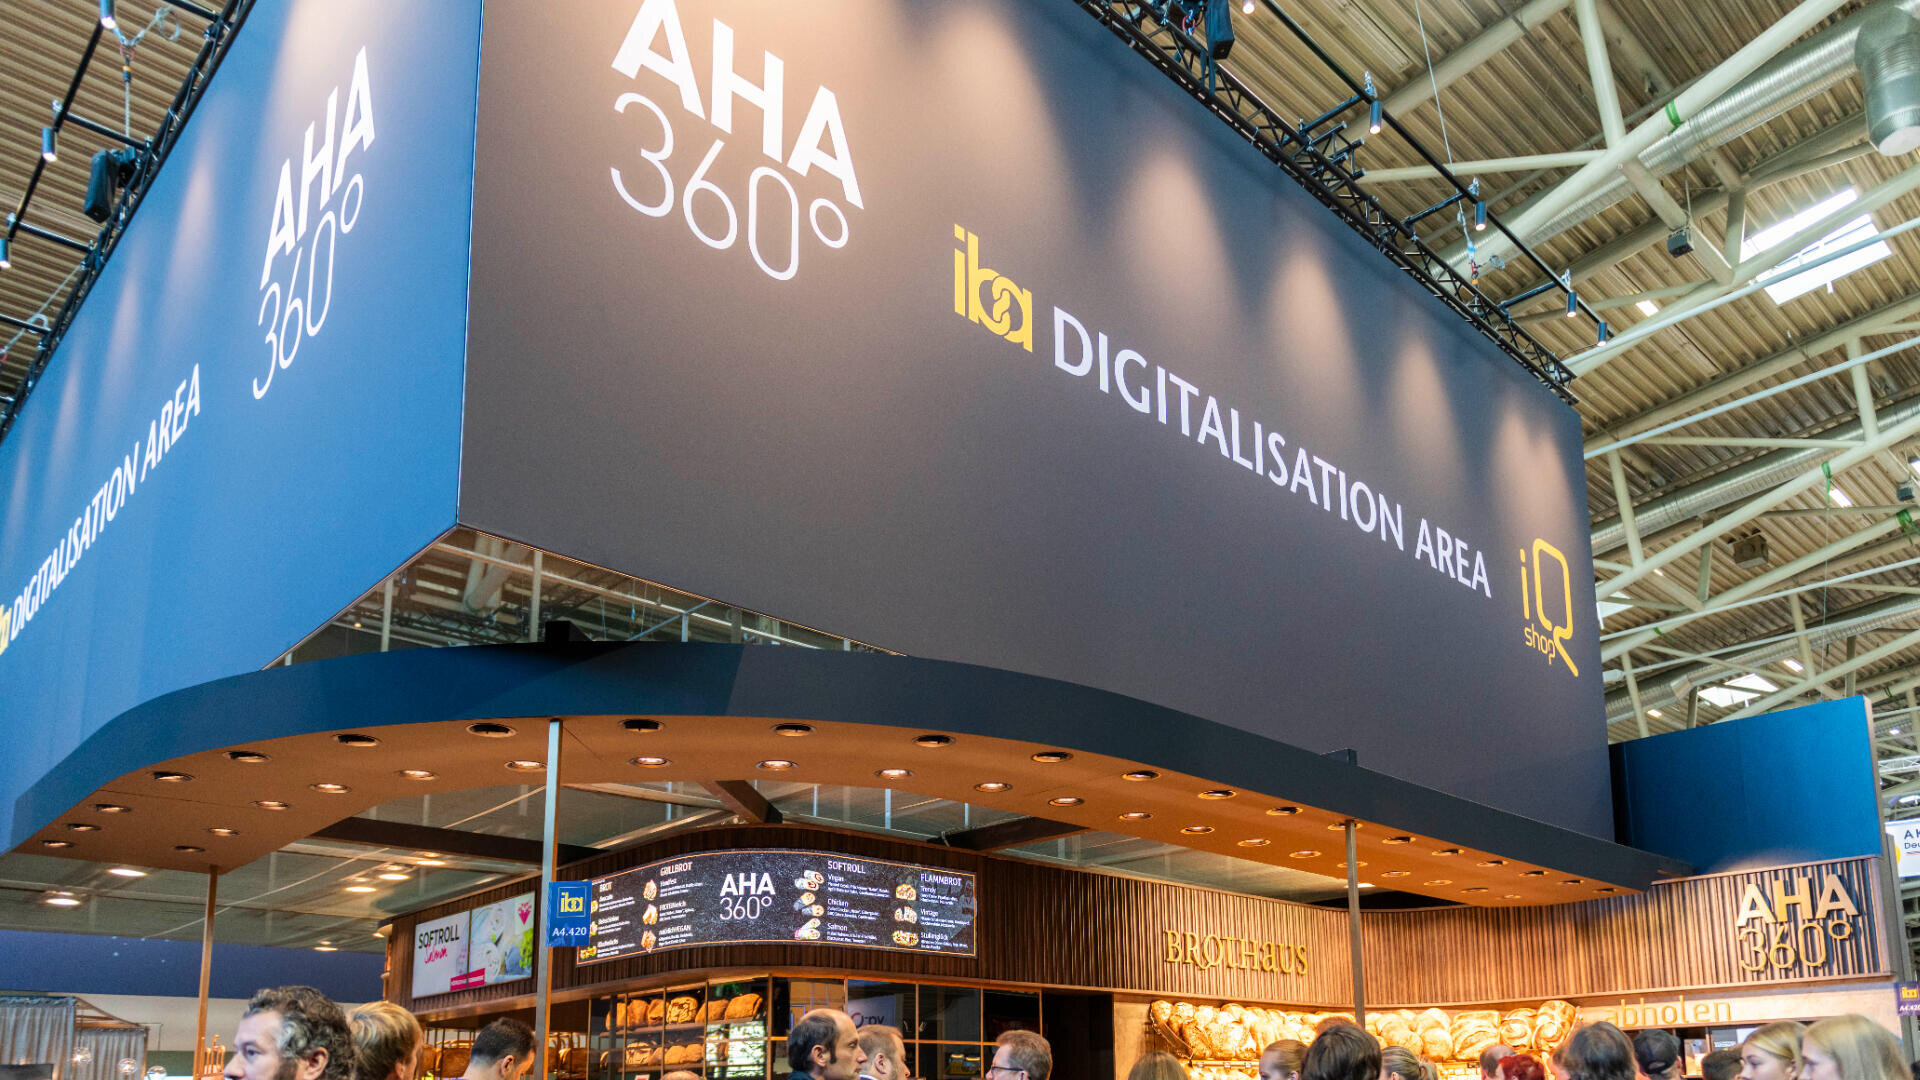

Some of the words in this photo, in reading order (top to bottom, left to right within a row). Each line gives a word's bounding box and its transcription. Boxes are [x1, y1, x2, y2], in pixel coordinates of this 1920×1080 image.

[610, 0, 865, 211] AHA
[260, 45, 375, 290] AHA
[610, 92, 849, 281] 360°
[252, 173, 364, 400] 360°
[954, 223, 1033, 353] iba
[1053, 305, 1404, 552] DIGITALISATION
[1415, 517, 1492, 599] AREA
[10, 440, 140, 641] DIGITALISATION
[140, 362, 201, 483] AREA
[1524, 623, 1556, 665] shop
[720, 872, 776, 897] AHA
[827, 860, 866, 874] SOFTROLL
[920, 873, 962, 887] FLAMMBROT
[560, 891, 584, 913] iba
[720, 896, 772, 920] 360°
[1736, 873, 1858, 928] AHA
[418, 924, 460, 949] SOFTROLL
[552, 927, 587, 937] A4.420
[1738, 920, 1851, 971] 360°
[1603, 995, 1732, 1027] abholen
